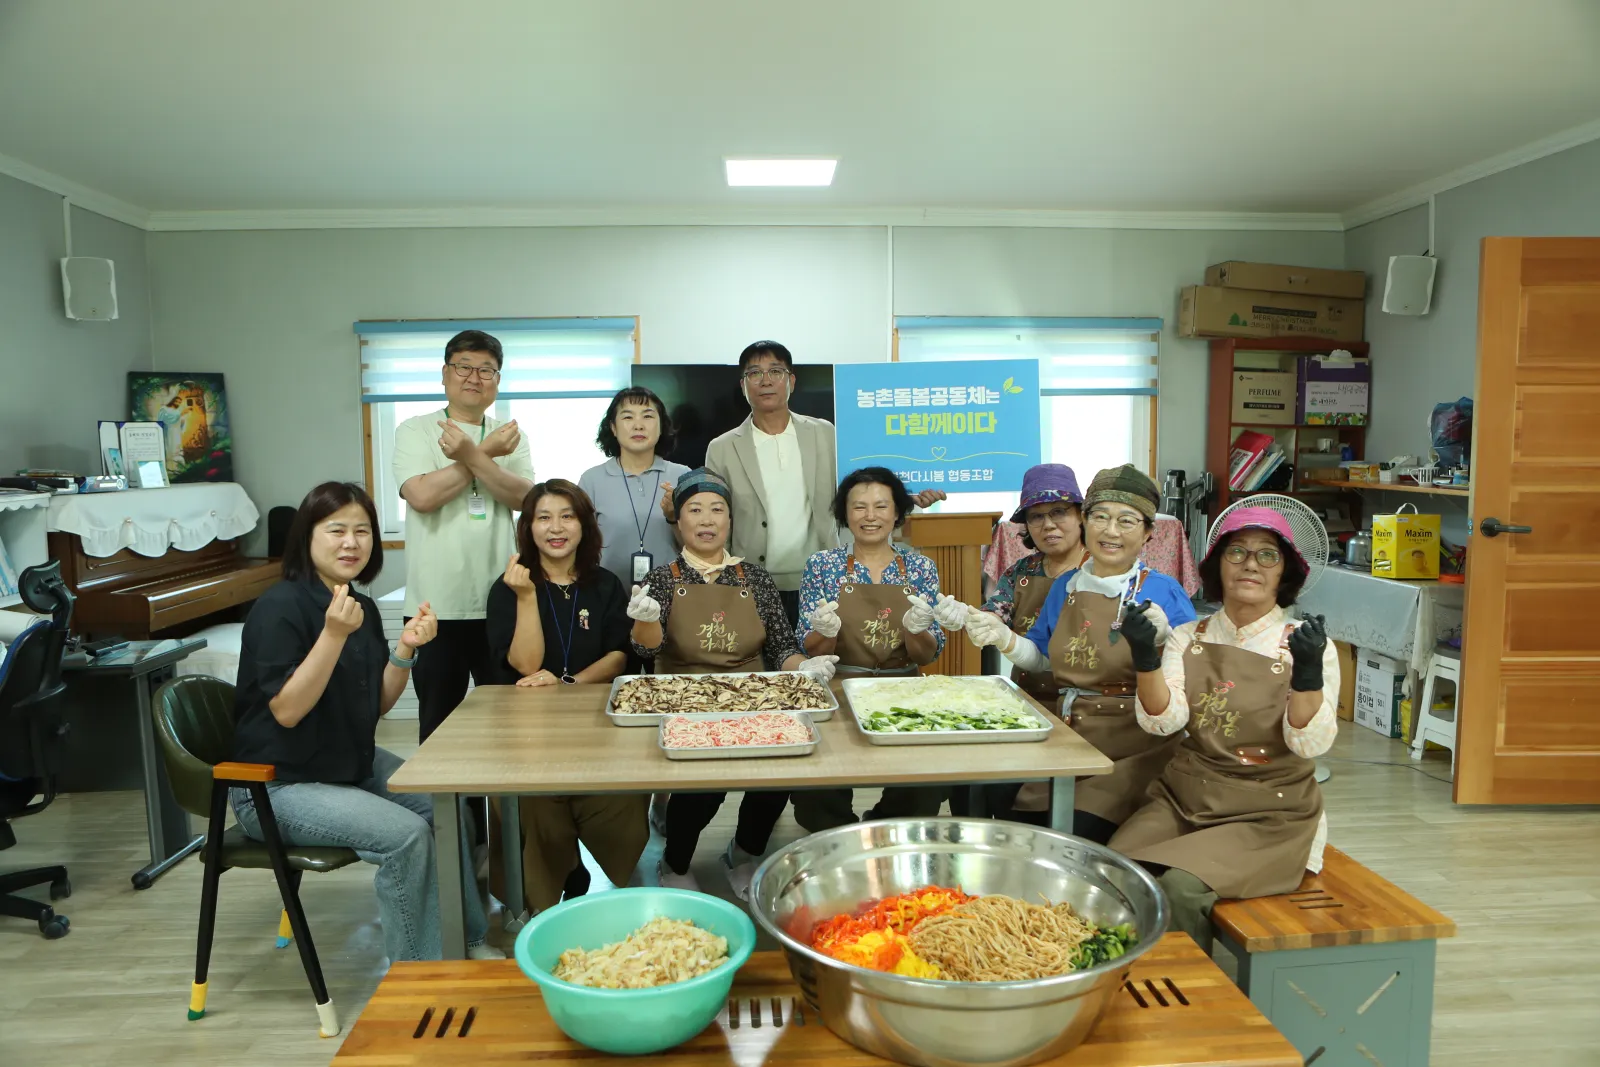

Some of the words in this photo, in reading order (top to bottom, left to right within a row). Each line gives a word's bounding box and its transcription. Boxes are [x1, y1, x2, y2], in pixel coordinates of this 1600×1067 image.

[856, 386, 1000, 408] 농촌돌봄공동체는
[1248, 388, 1282, 397] PERFUME
[885, 411, 998, 436] 다함께이다
[948, 469, 994, 482] 협동조합
[1375, 528, 1393, 538] Maxim
[1404, 528, 1433, 538] Maxim
[1357, 692, 1374, 709] 종이컵
